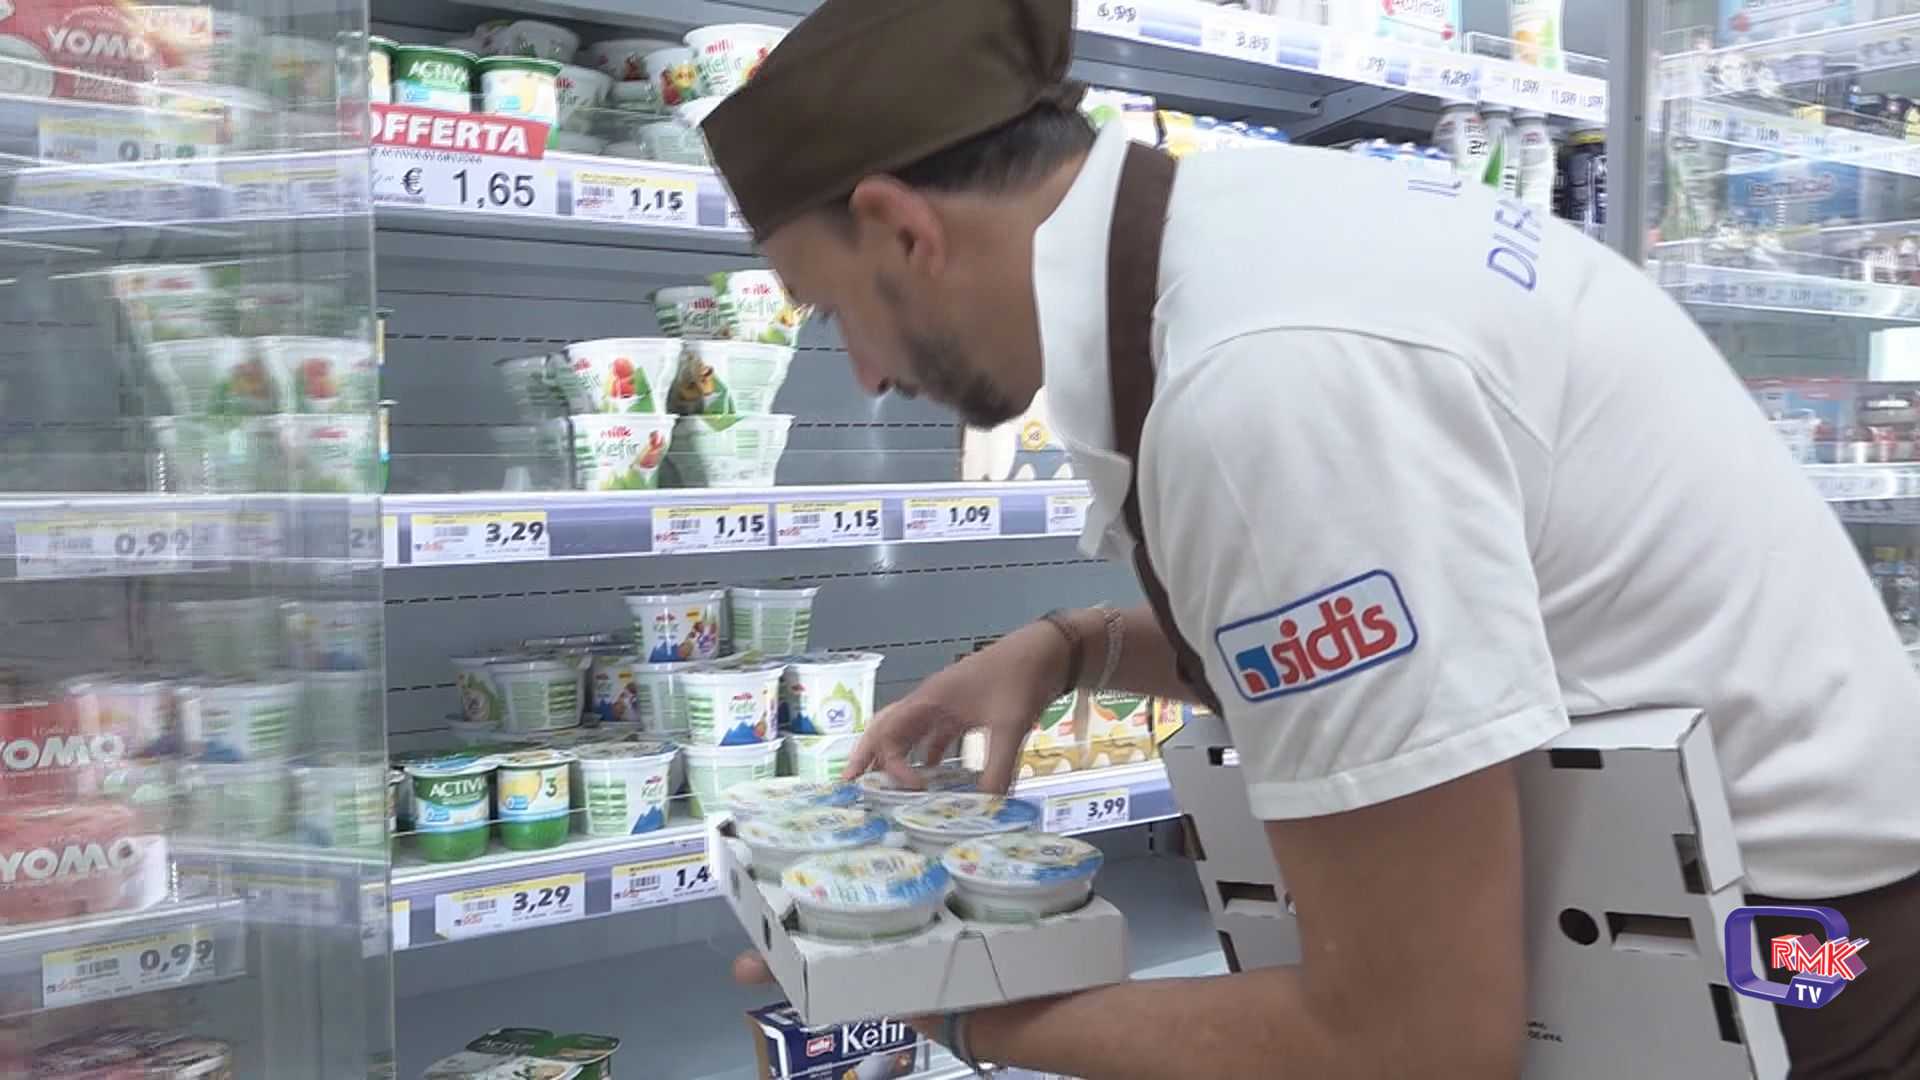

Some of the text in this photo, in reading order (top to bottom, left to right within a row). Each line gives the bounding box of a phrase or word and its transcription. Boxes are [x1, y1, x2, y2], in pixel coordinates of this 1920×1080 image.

[401, 167, 536, 209] € 1,65
[630, 187, 684, 212] 1,15
[716, 513, 765, 538] 1,15
[834, 509, 879, 533] 1,15
[949, 505, 990, 527] 1,09
[485, 520, 545, 546] 3,29
[1272, 596, 1398, 685] sidis
[0, 733, 126, 770] OMO
[545, 778, 558, 798] 3
[1087, 797, 1127, 819] 3,99
[0, 838, 142, 882] YOMO
[512, 885, 571, 913] 3,29
[139, 938, 214, 974] 0,99
